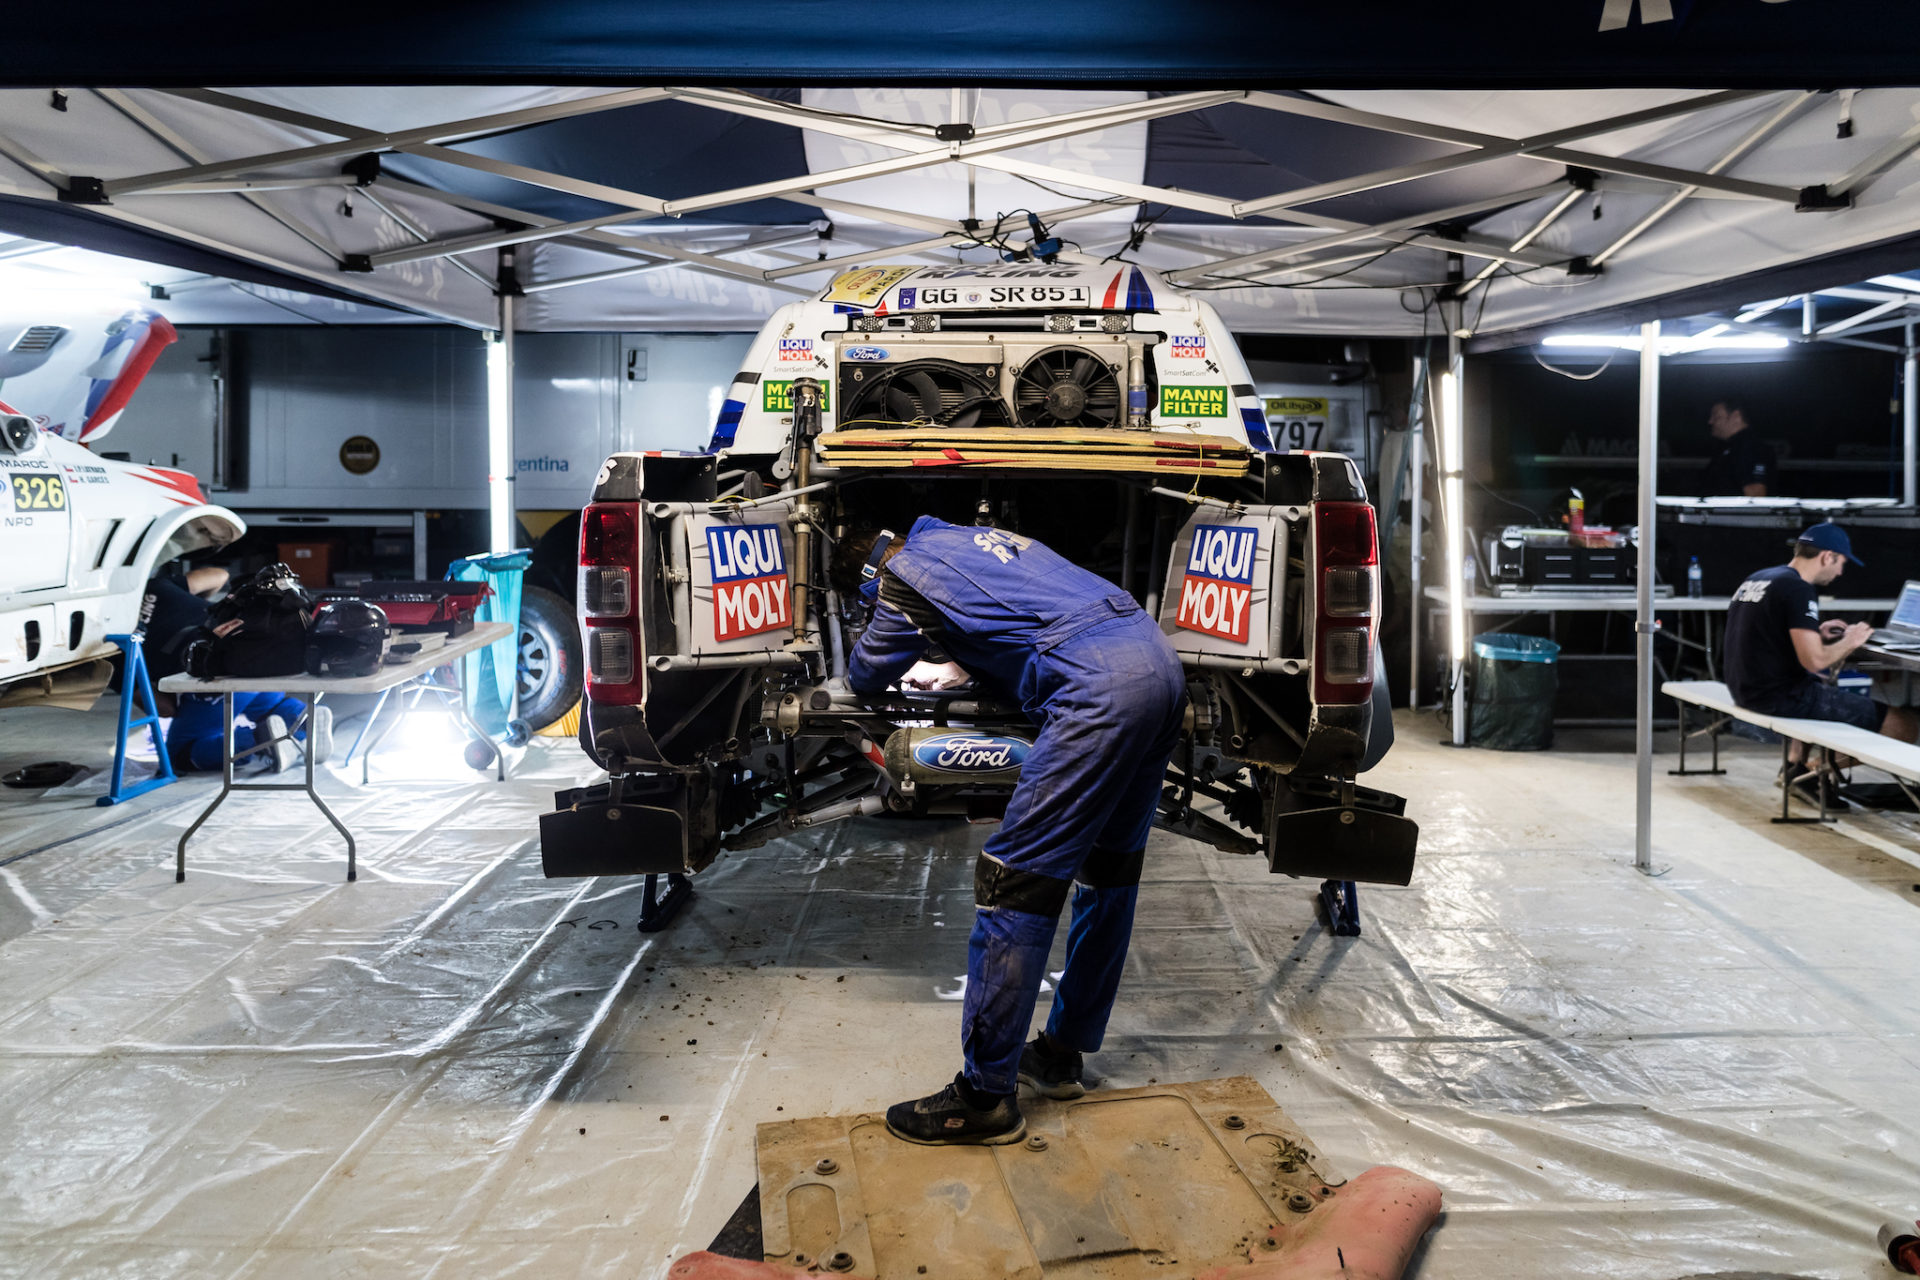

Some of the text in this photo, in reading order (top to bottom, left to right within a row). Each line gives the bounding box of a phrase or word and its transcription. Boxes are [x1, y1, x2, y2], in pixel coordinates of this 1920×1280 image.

[922, 287, 1086, 304] GG SR 851
[780, 340, 812, 350] LIQUI
[1172, 336, 1205, 347] LIQUI
[780, 350, 812, 360] MOLY
[853, 348, 880, 359] Ford
[1172, 347, 1205, 358] MOLY
[1164, 388, 1224, 402] MANN
[1163, 402, 1223, 415] FILTER
[1270, 422, 1324, 450] 797
[14, 477, 65, 509] 326
[710, 528, 783, 578] LIQUI
[1189, 529, 1255, 579] LIQUI
[717, 579, 787, 635] MOLY
[1179, 580, 1250, 635] MOLY
[938, 738, 1012, 767] Ford
